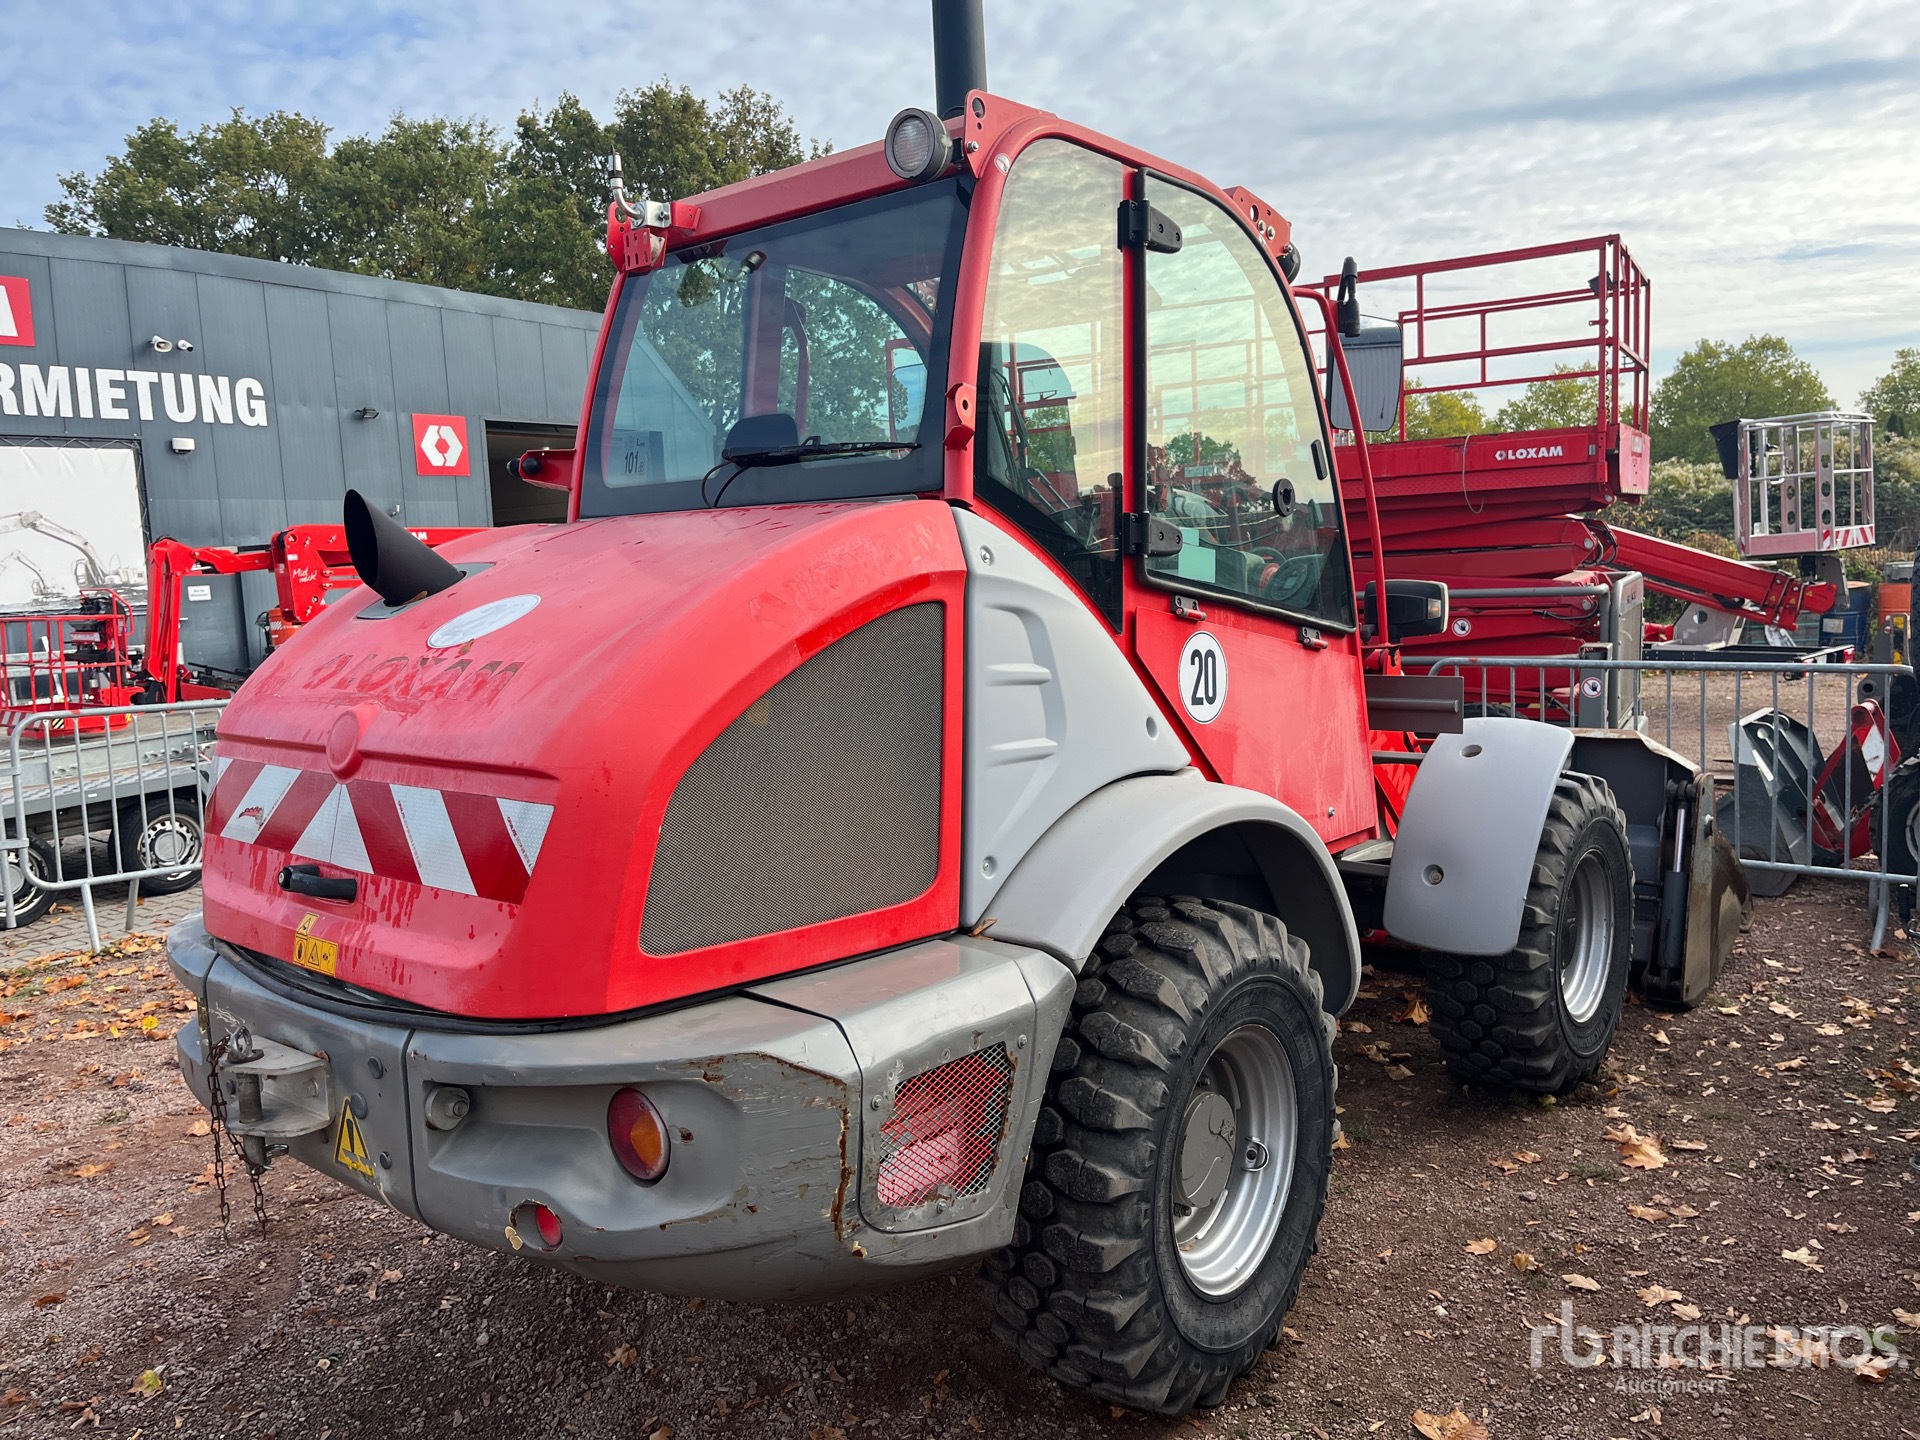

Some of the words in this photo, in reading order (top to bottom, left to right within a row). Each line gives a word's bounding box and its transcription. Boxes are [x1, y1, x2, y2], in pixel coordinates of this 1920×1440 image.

[624, 450, 639, 474] 101
[1507, 446, 1563, 460] LOXAM
[1190, 648, 1217, 706] 20
